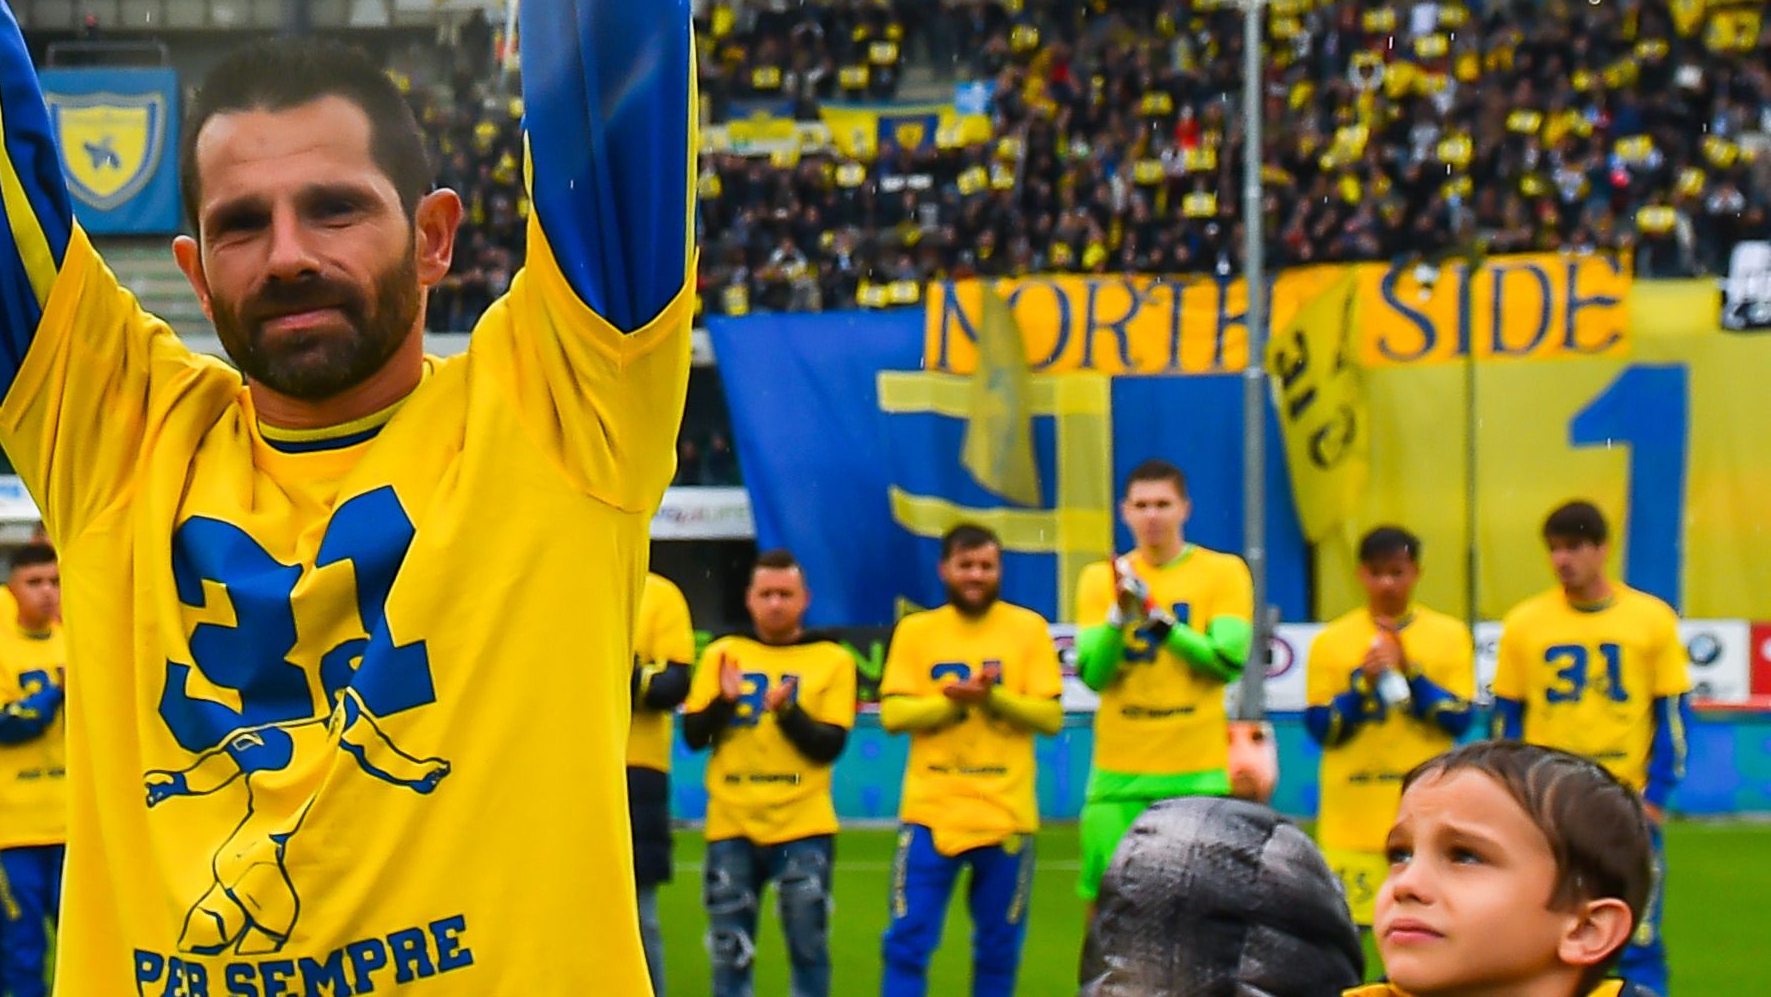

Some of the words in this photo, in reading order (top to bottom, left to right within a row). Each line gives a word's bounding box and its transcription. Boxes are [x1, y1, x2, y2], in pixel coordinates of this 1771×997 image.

[1376, 256, 1626, 362] SIDE
[158, 484, 437, 756] 31
[1544, 642, 1629, 704] 31
[133, 948, 216, 997] PER
[224, 914, 475, 997] SEMPRE
